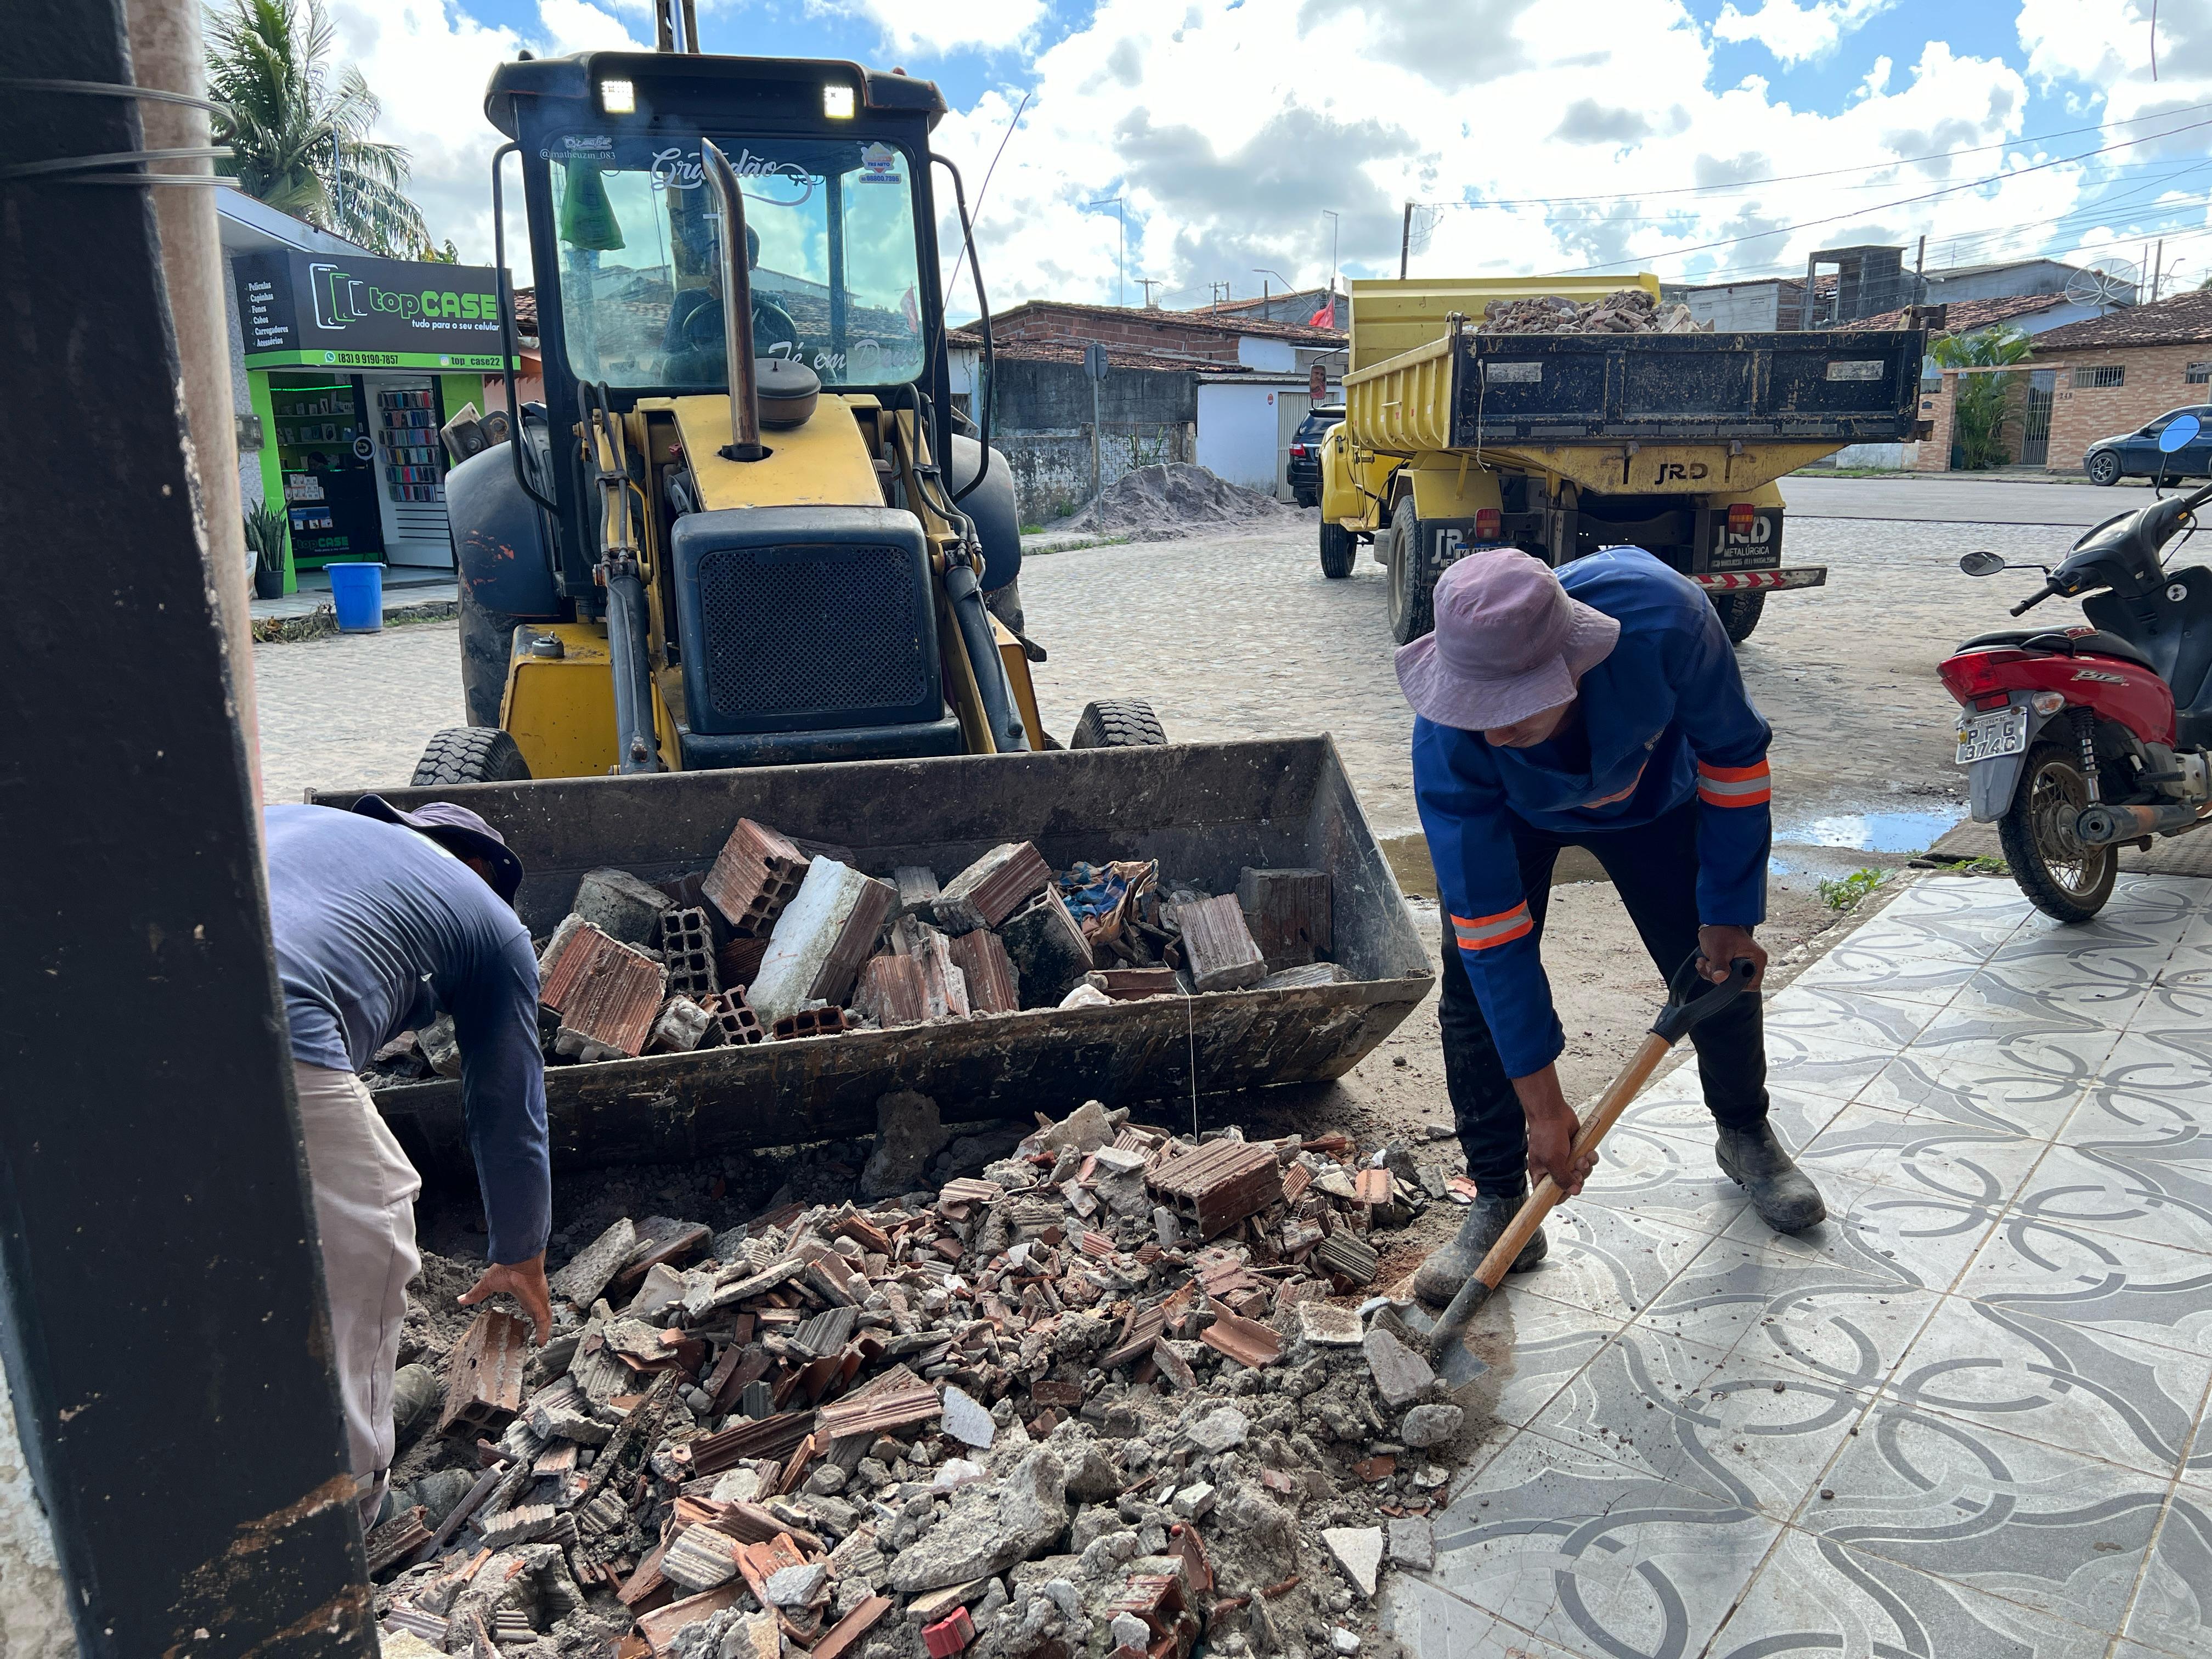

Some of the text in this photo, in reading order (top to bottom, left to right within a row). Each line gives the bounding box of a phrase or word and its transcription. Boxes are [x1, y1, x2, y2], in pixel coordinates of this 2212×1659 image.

[540, 149, 616, 160] @matheuzin_083
[651, 144, 782, 191] Gradão
[250, 293, 274, 303] Capinhas
[369, 287, 497, 320] topCASE
[253, 316, 269, 324] Cabos
[412, 319, 430, 328] tudo
[432, 321, 450, 330] para
[475, 321, 500, 331] celular
[255, 325, 289, 336] Carregadores
[257, 336, 283, 347] Acessórios
[338, 353, 398, 364] (83) 9 9190-7857
[452, 357, 500, 366] top_case22
[814, 353, 847, 370] em
[1655, 463, 1708, 485] JRD
[1431, 529, 1473, 564] JR
[1724, 544, 1770, 557] METALÚRGICA
[2075, 669, 2125, 682] Biz
[1968, 721, 2015, 745] PFG
[1964, 736, 2016, 760] 3740
